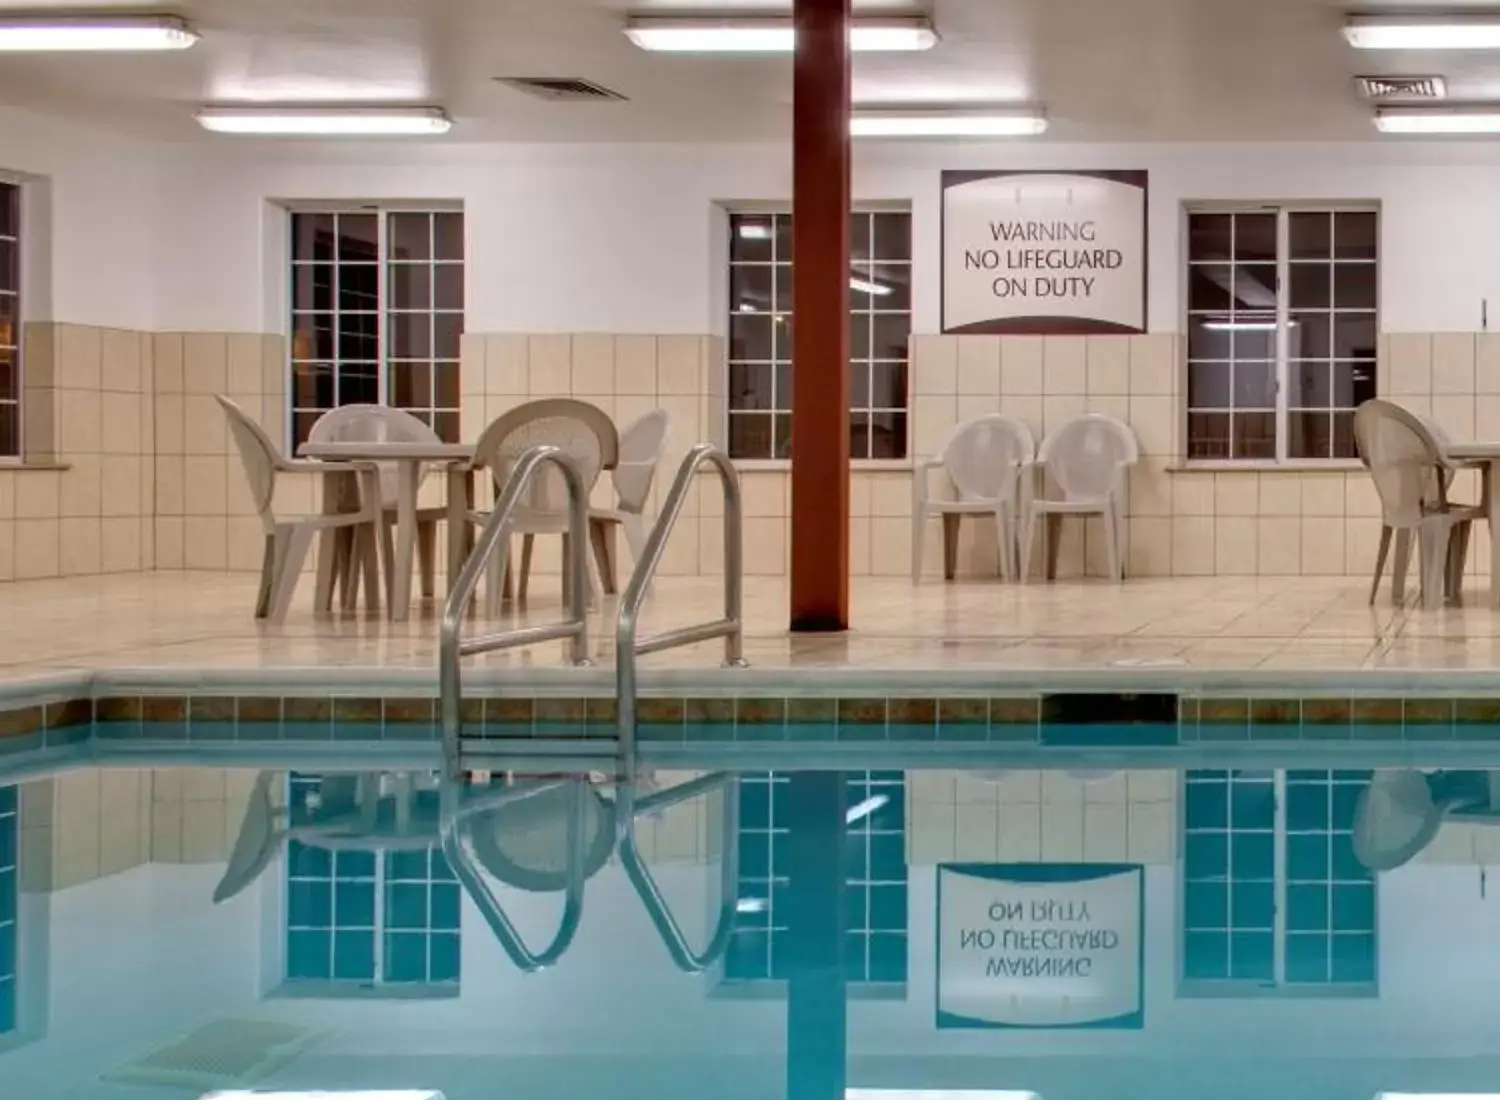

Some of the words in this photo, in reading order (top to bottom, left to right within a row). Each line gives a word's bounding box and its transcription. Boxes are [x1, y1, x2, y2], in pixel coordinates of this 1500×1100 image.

[989, 221, 1096, 241] WARNING
[965, 249, 999, 269] NO
[1007, 249, 1122, 269] LIFEGUARD
[992, 277, 1027, 297] ON
[1035, 277, 1095, 297] DUTY
